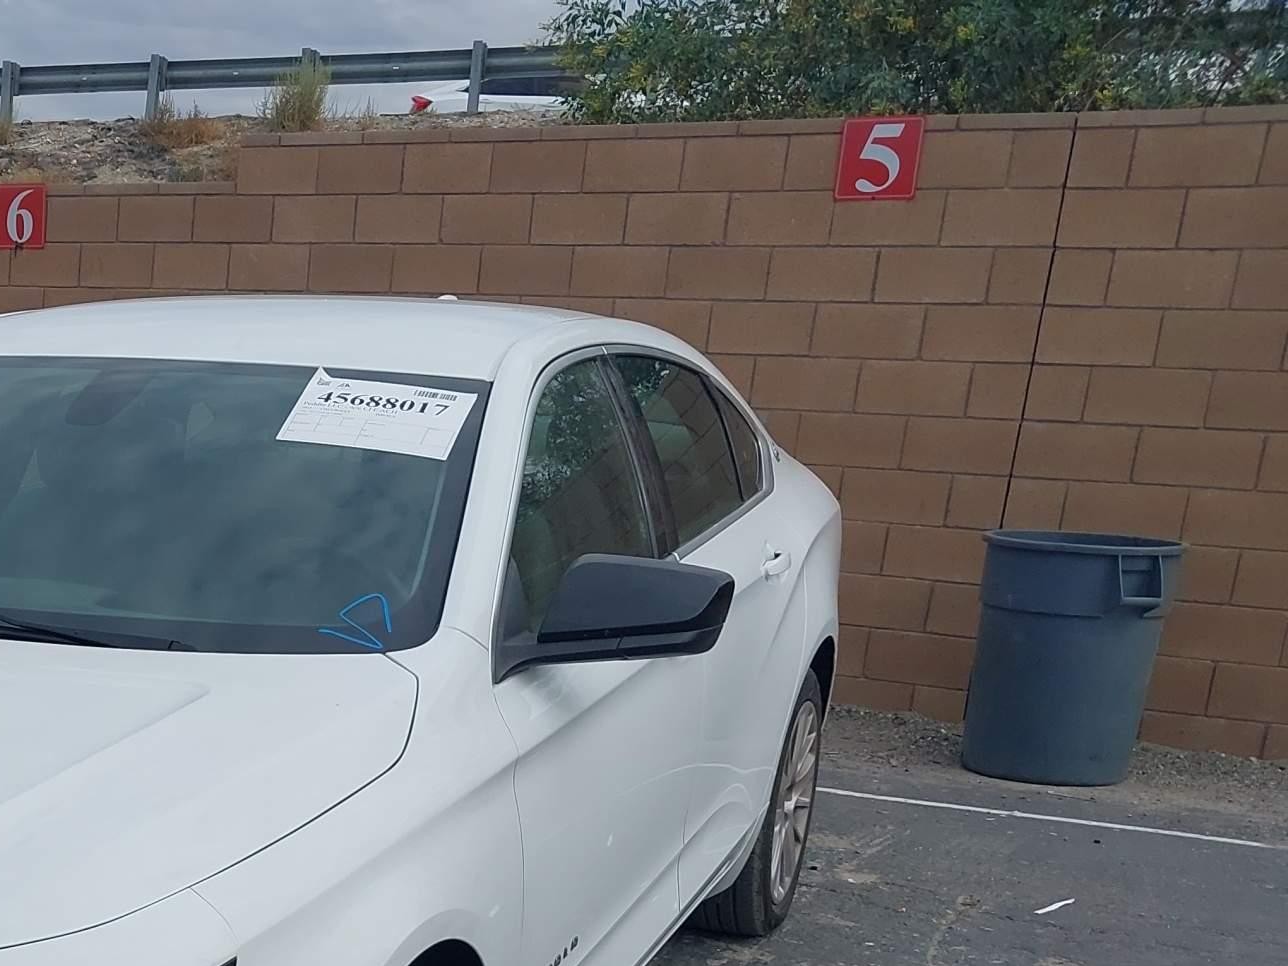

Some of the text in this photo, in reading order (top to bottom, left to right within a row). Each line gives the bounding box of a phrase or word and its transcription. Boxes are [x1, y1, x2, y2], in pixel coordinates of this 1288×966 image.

[855, 123, 906, 193] 5
[6, 188, 35, 244] 6
[316, 390, 451, 416] 45688017
